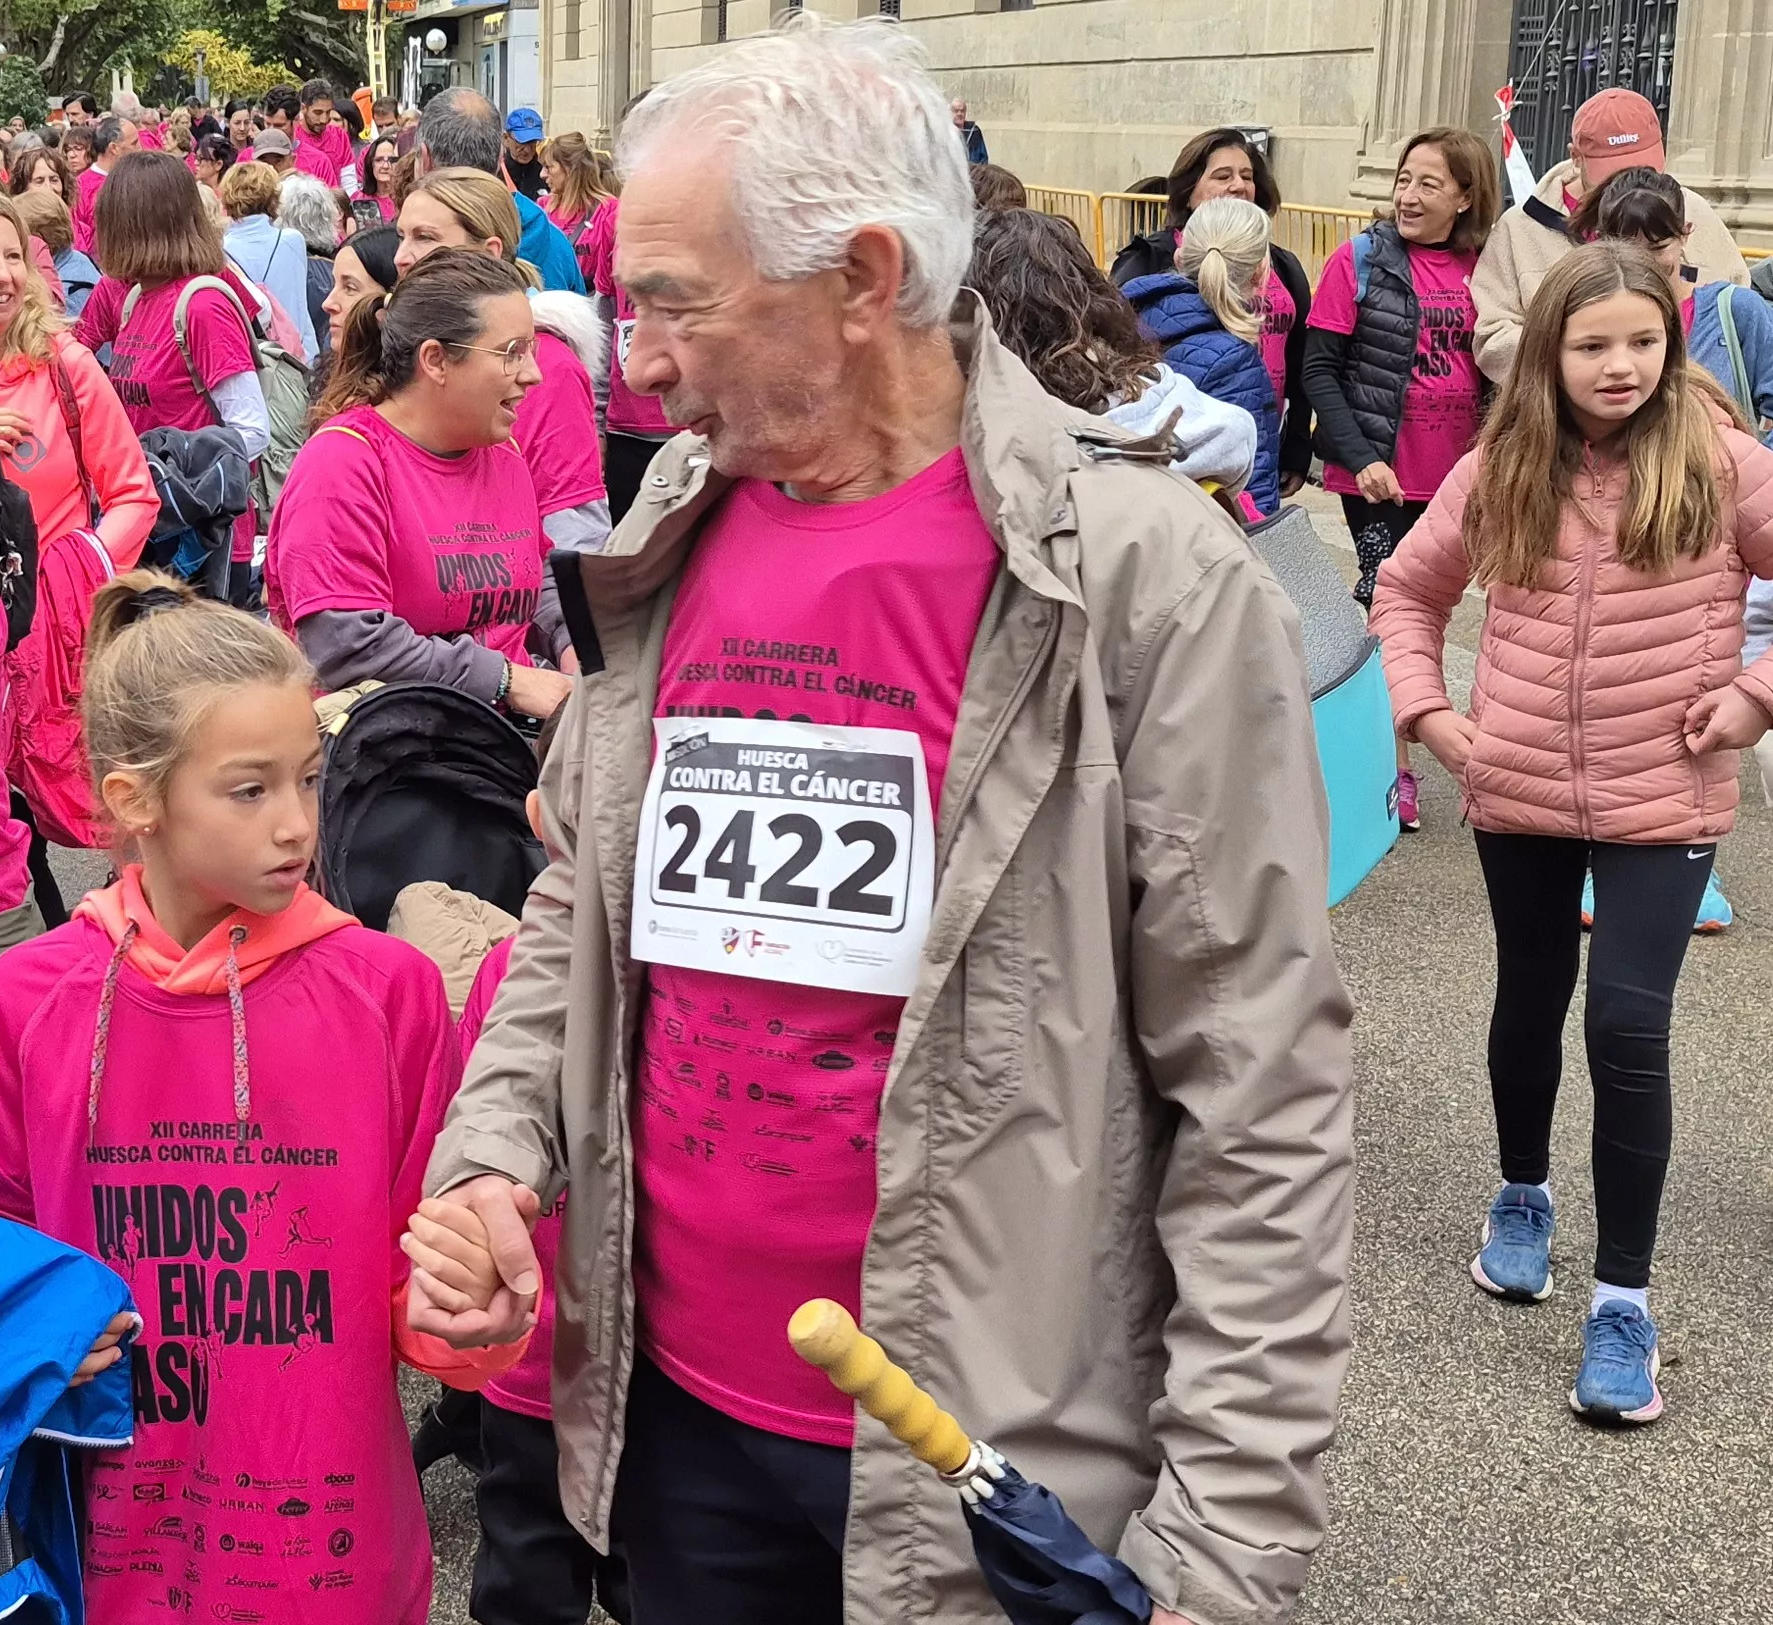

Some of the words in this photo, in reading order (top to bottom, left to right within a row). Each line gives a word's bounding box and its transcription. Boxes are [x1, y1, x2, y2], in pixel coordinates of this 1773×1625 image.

[434, 553, 512, 594] UNIDOS
[466, 589, 496, 628] EN
[743, 638, 840, 668] CARRERA
[725, 663, 797, 689] CONTRA
[803, 671, 827, 693] EL
[833, 671, 918, 712] CÁNCER
[737, 749, 809, 770] HUESCA
[669, 766, 752, 793] CONTRA
[757, 772, 784, 795] EL
[790, 770, 902, 806] CÁNCER
[658, 804, 898, 917] 2422
[150, 1121, 175, 1139] XII
[86, 1145, 153, 1164] HUESCA
[157, 1144, 227, 1164] CONTRA
[233, 1146, 255, 1165] EL
[260, 1142, 339, 1167] CÁNCER
[92, 1184, 249, 1264] UNIDOS
[157, 1263, 207, 1337] EN
[212, 1268, 335, 1346] CADA
[132, 1341, 210, 1428] ASO
[219, 1499, 265, 1513] URBAN
